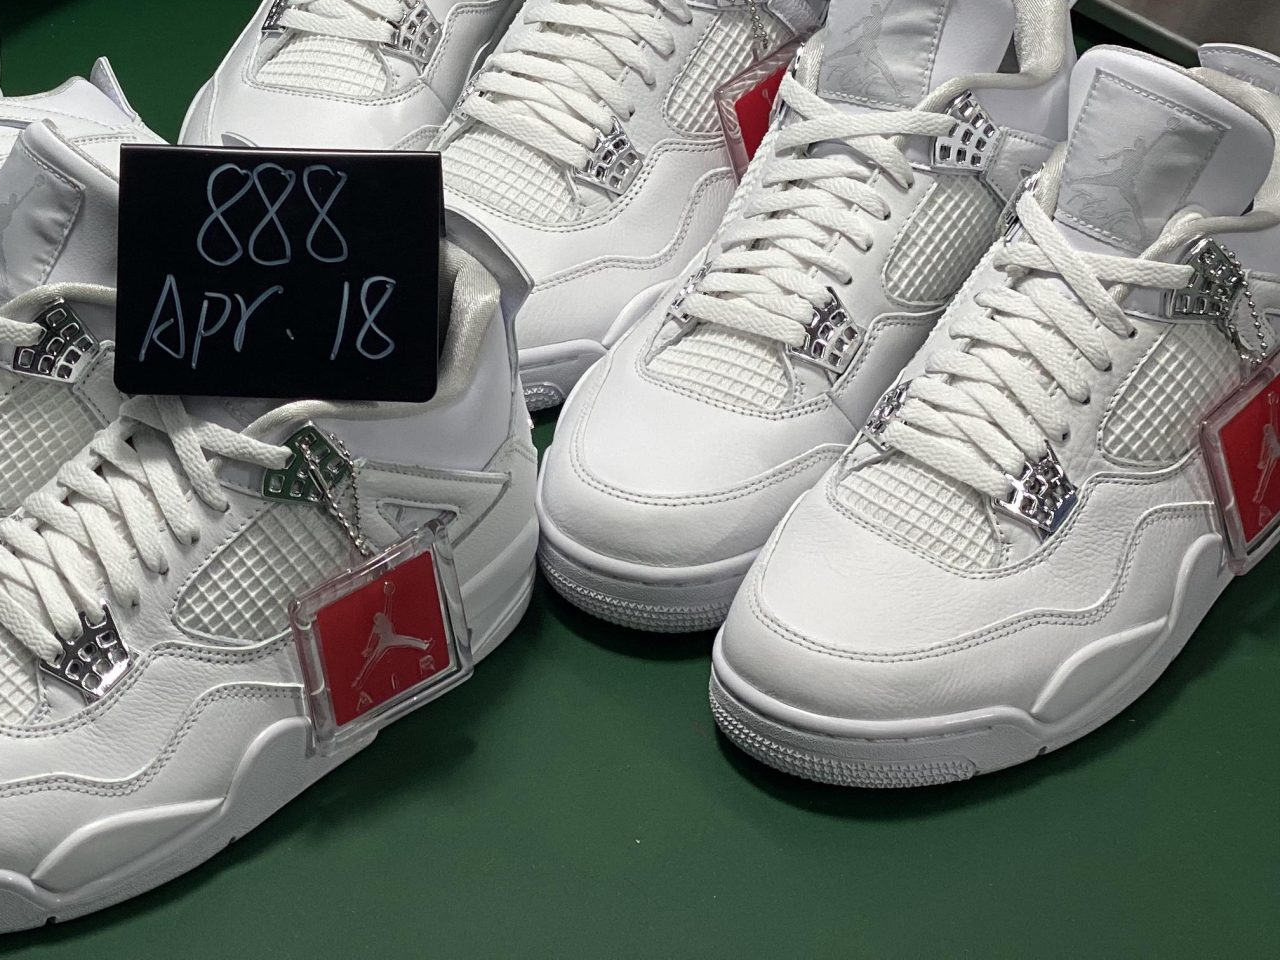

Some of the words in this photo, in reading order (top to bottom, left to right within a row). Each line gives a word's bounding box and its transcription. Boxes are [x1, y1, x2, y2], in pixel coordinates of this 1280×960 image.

[196, 162, 349, 267] 888
[329, 275, 397, 361] 18
[355, 653, 436, 713] AIR
